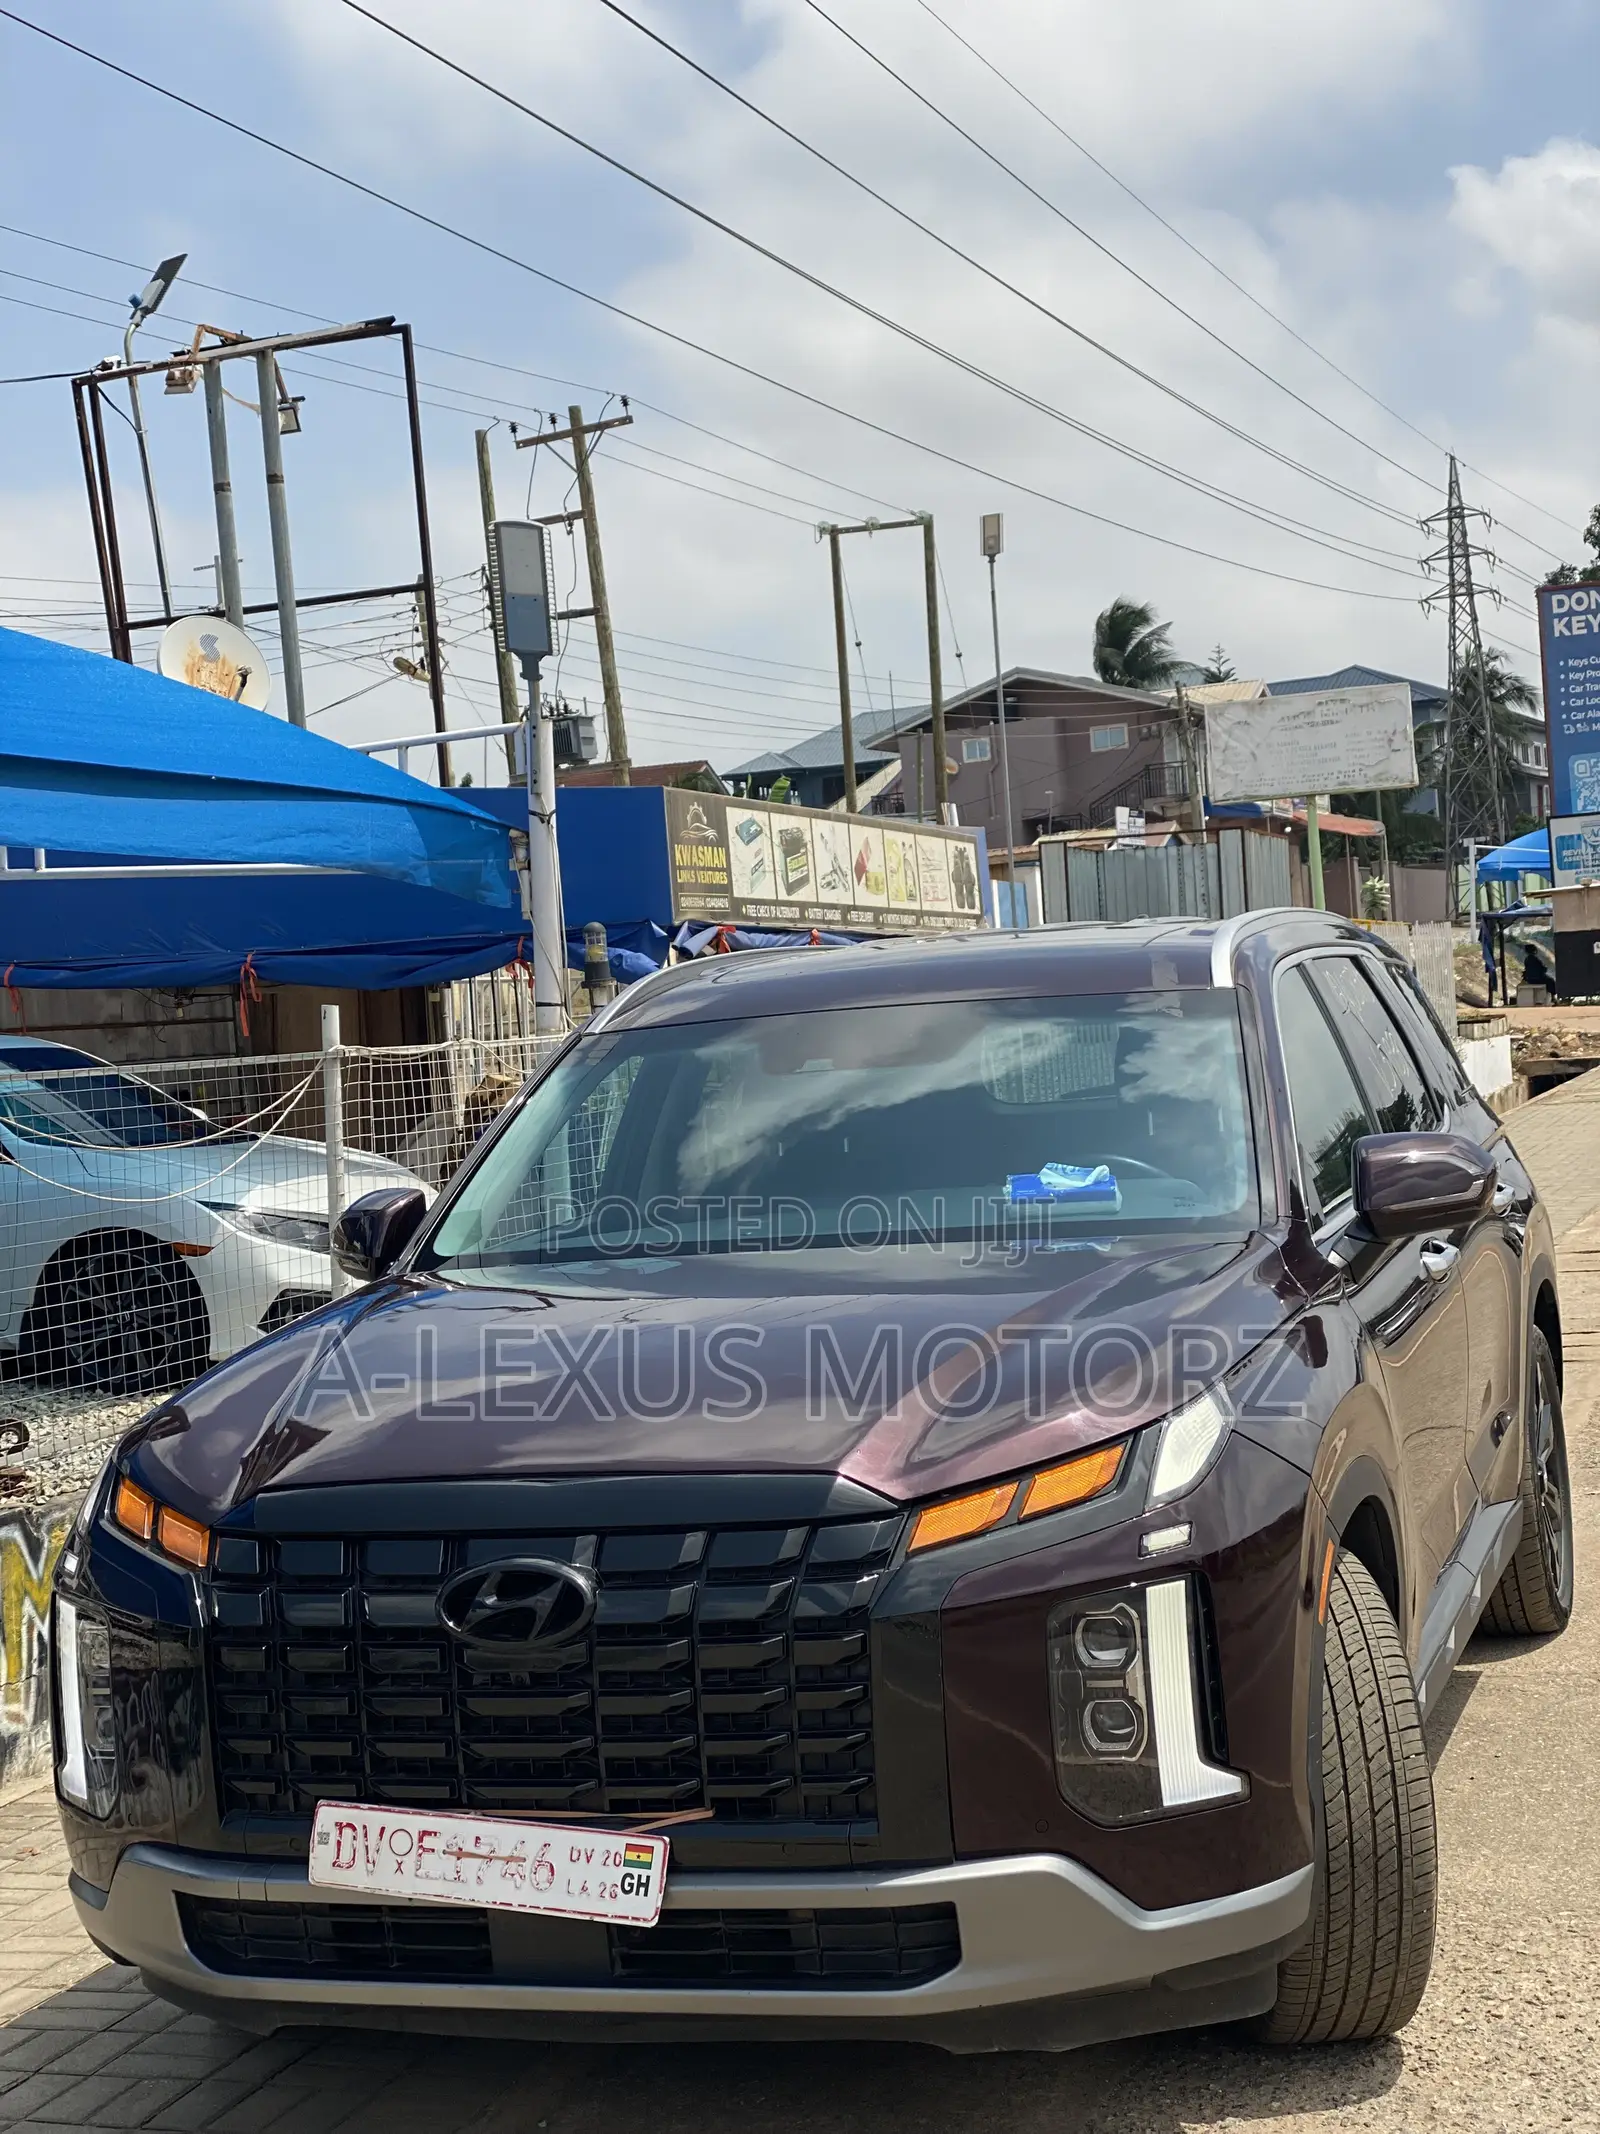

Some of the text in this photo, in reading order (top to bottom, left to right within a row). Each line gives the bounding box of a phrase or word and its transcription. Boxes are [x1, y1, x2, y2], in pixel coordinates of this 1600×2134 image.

[1553, 614, 1600, 637] KEY
[1568, 657, 1588, 668] Keys
[1569, 671, 1585, 681] Key
[1569, 685, 1584, 693] Car
[1569, 698, 1584, 707] Car
[1570, 711, 1585, 720] Car
[675, 844, 727, 868] KWASMAN
[696, 871, 728, 885] VENTURES
[747, 905, 757, 917] FREE
[757, 905, 770, 917] CHECK
[809, 908, 842, 920] BATTERY CHARGING
[332, 1821, 387, 1876] DV
[568, 1845, 595, 1865] DV
[620, 1872, 651, 1898] GH
